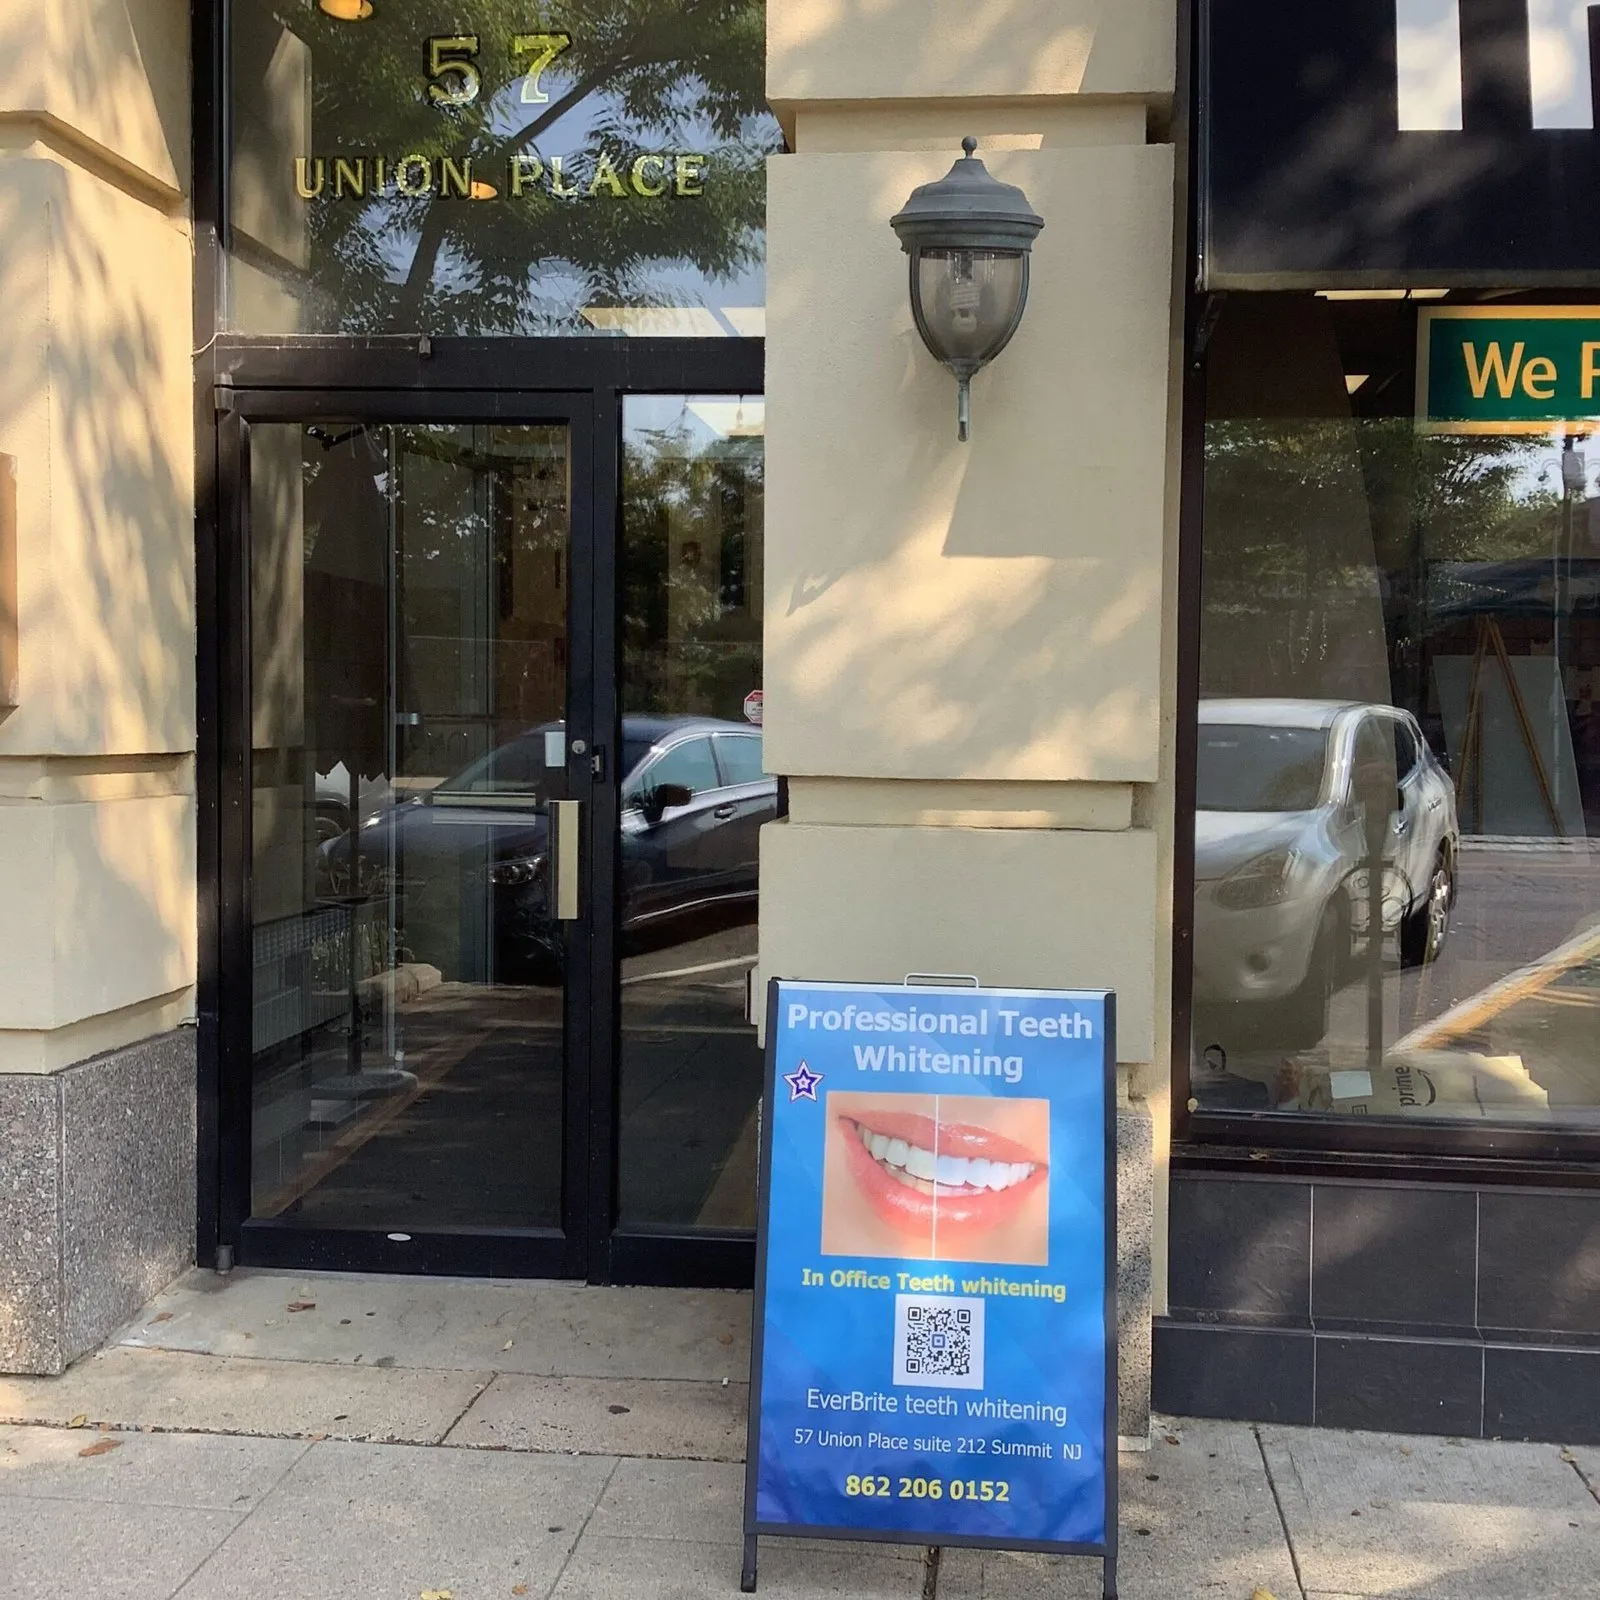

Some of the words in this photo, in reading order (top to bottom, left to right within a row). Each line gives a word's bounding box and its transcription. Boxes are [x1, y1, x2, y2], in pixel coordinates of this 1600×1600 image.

[425, 34, 571, 107] 57
[294, 155, 475, 199] UNION
[507, 153, 705, 198] PLACE
[1462, 342, 1557, 400] We
[788, 1004, 988, 1035] Professional
[998, 1011, 1093, 1040] Teeth
[853, 1045, 1023, 1083] Whitening
[1392, 1066, 1422, 1106] prime
[801, 1268, 824, 1287] In
[830, 1270, 891, 1290] Office
[896, 1273, 955, 1293] Teeth
[962, 1277, 1065, 1302] whitening
[807, 1389, 898, 1412] EverBrite
[905, 1393, 958, 1416] teeth
[966, 1396, 1068, 1427] whitening
[794, 1429, 813, 1445] 57
[818, 1430, 862, 1448] Union
[868, 1432, 908, 1450] Place
[913, 1434, 952, 1452] suite
[956, 1438, 986, 1454] 212
[991, 1440, 1053, 1459] Summit
[1063, 1443, 1082, 1460] NJ
[846, 1475, 891, 1497] 862
[899, 1478, 943, 1500] 206
[950, 1480, 1010, 1501] 0152
